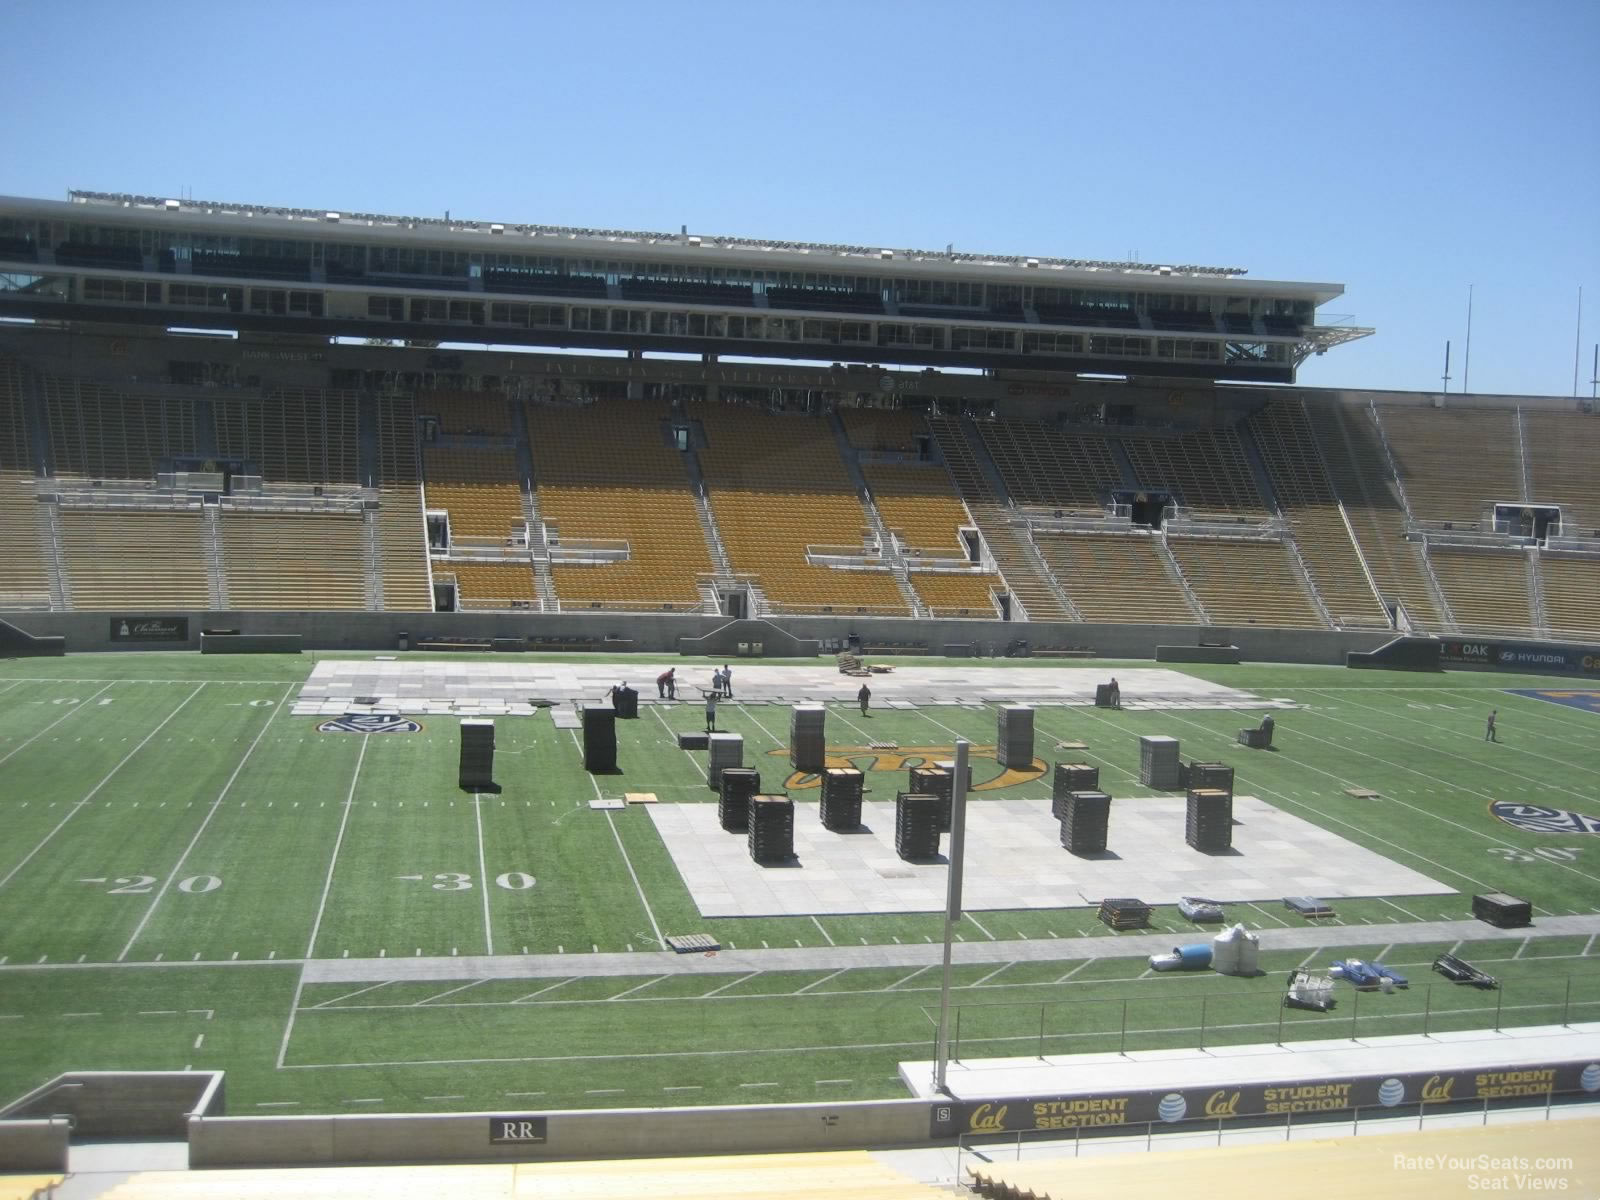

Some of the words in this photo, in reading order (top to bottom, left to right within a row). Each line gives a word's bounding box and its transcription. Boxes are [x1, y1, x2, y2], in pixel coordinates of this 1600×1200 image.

[1463, 644, 1488, 656] OAK
[1518, 653, 1565, 664] HYUNDAI
[1475, 1070, 1556, 1087] STUDENT
[1263, 1084, 1351, 1101] STUDENT
[1421, 1075, 1455, 1102] Cal
[1477, 1082, 1553, 1098] SECTION
[1033, 1098, 1128, 1116] STUDENT
[1206, 1090, 1240, 1117] Cal
[1265, 1098, 1348, 1114] SECTION
[970, 1103, 1008, 1131] Cal
[1036, 1112, 1125, 1130] SECTION
[502, 1121, 534, 1138] RR
